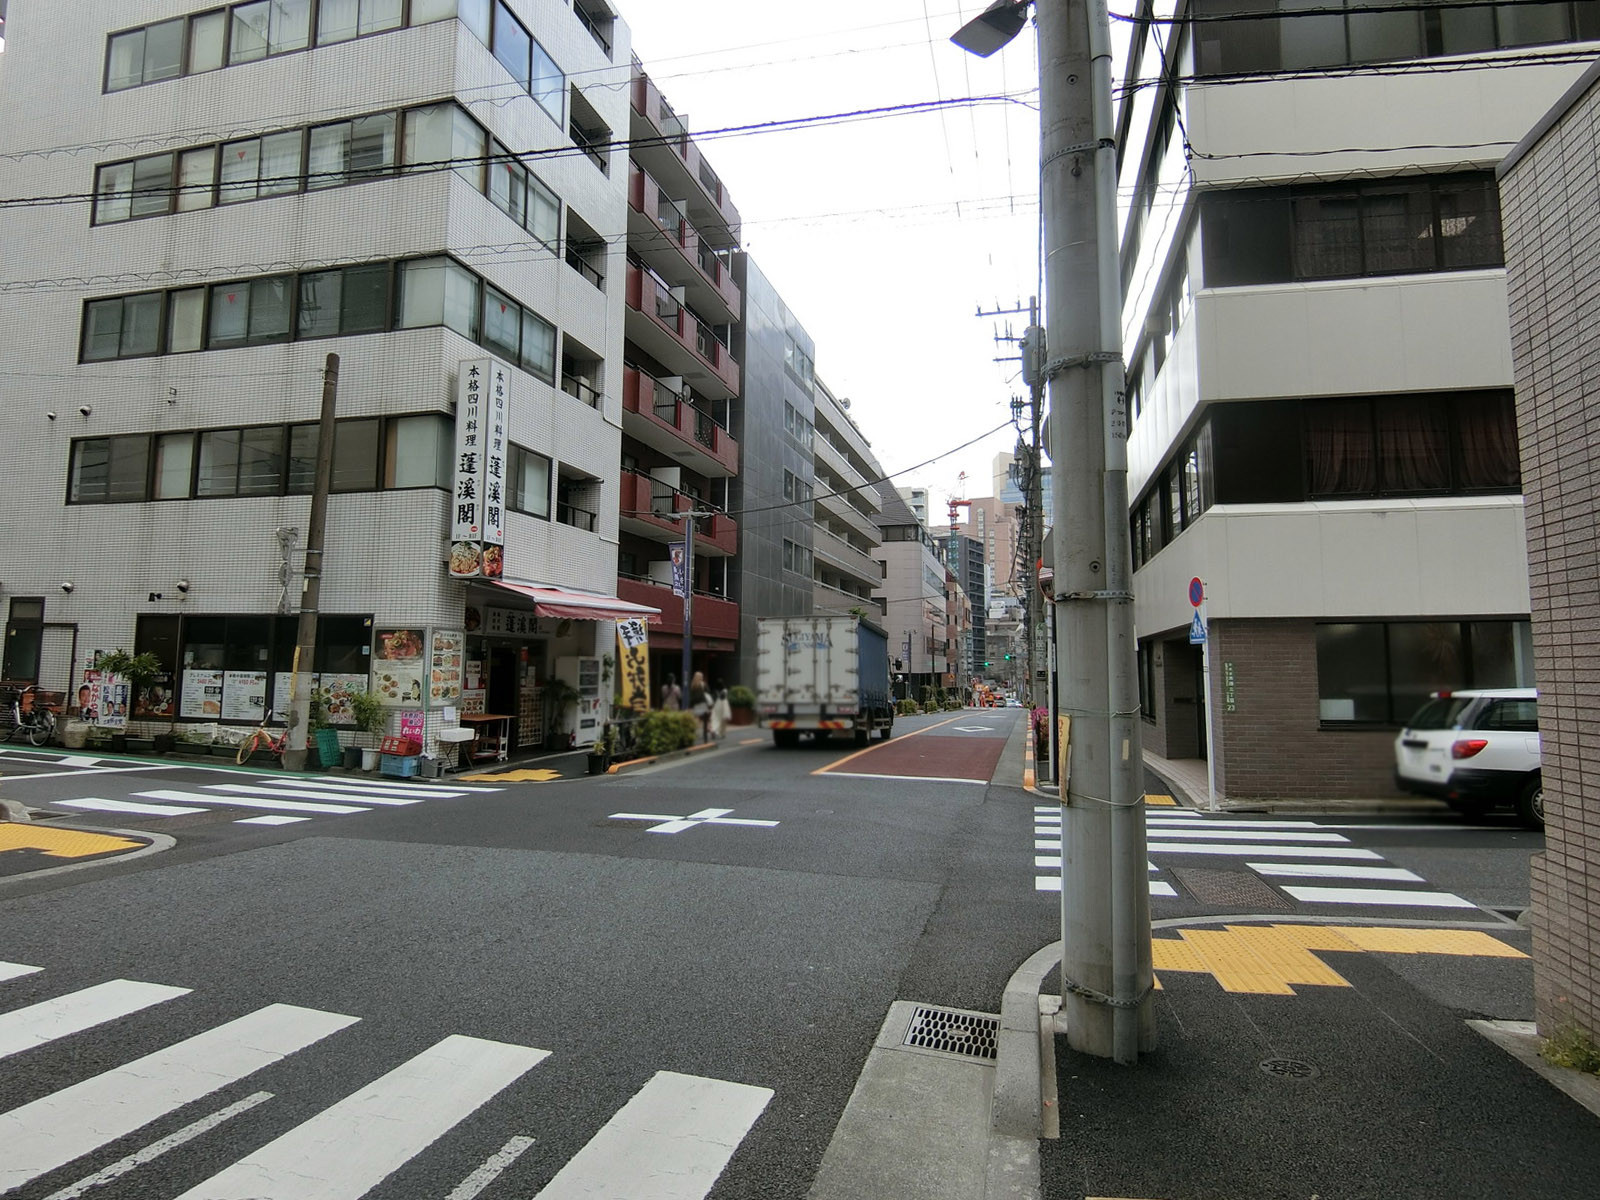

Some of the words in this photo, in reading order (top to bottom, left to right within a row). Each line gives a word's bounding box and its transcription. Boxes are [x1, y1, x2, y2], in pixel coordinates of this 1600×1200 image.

[465, 365, 480, 447] 本格四川料理
[493, 370, 504, 451] 本格四川料理
